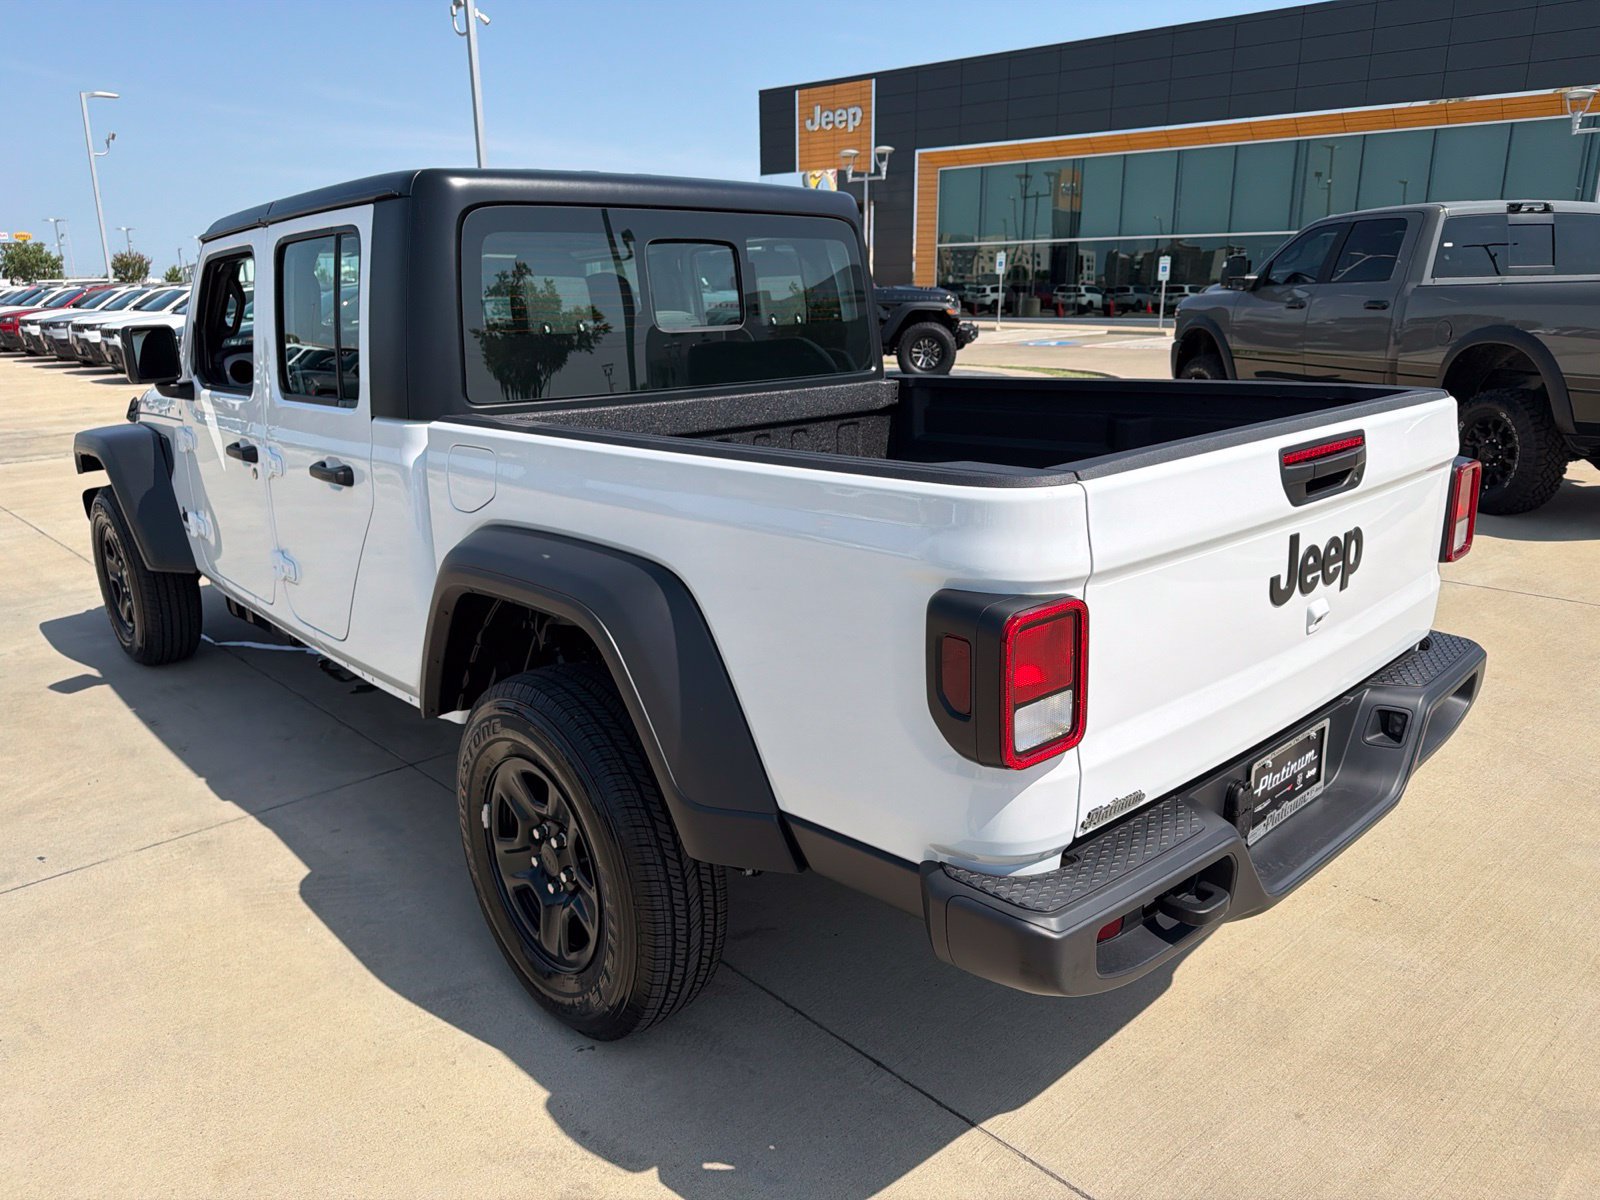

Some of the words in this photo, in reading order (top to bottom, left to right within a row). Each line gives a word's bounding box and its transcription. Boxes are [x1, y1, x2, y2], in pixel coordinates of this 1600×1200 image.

[805, 104, 863, 132] Jeep
[1269, 526, 1363, 608] Jeep
[1254, 749, 1318, 797] Platinum
[1081, 789, 1146, 830] Platinum
[1264, 792, 1309, 831] Platinum
